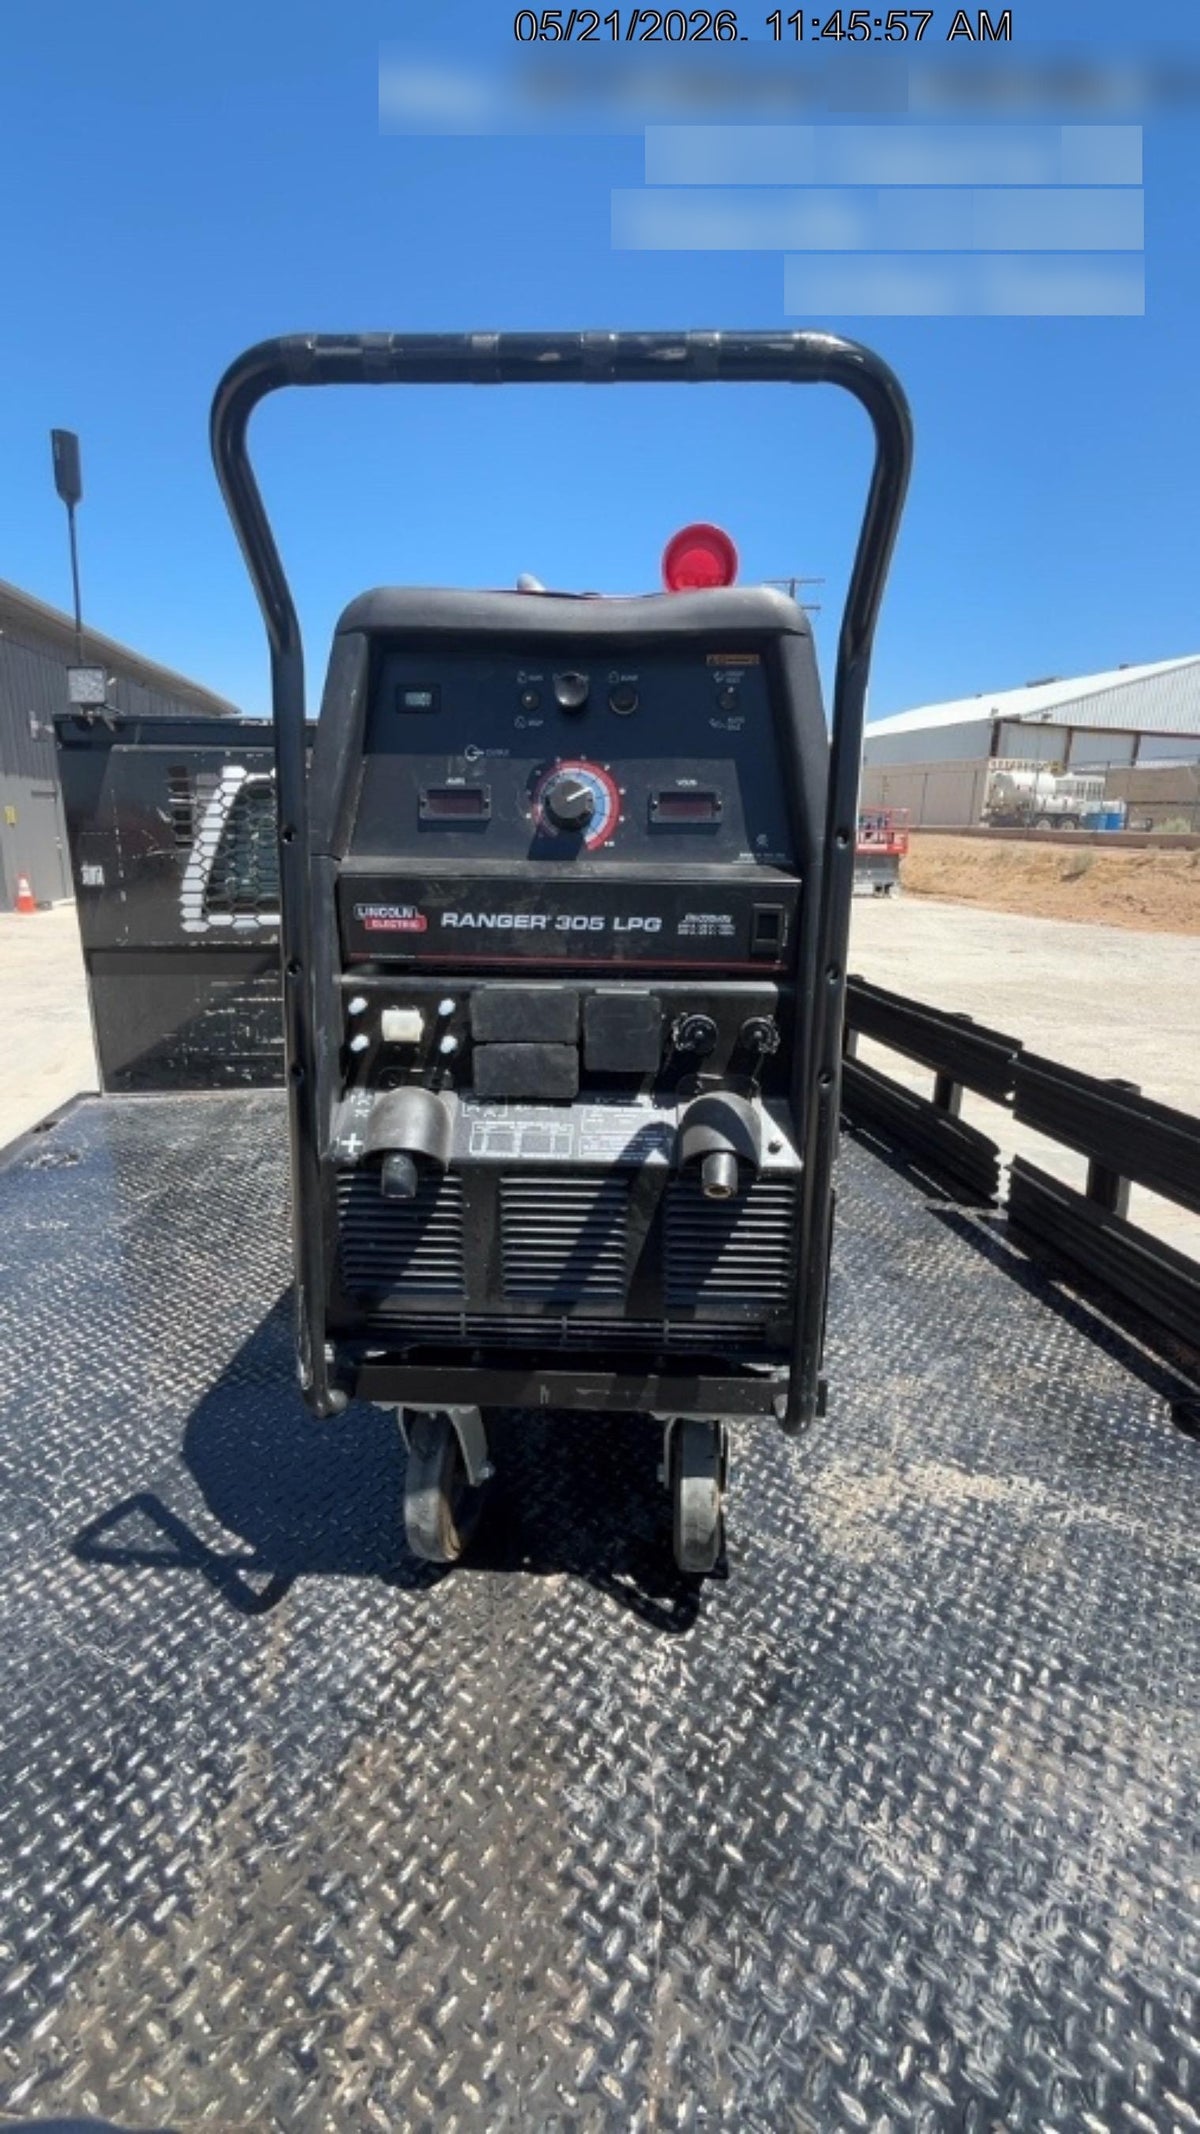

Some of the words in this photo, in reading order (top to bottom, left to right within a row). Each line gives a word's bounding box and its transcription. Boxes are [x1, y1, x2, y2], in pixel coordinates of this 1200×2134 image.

[357, 907, 413, 918] LINCOLN
[440, 912, 547, 929] RANGER
[555, 914, 606, 931] 305
[613, 917, 663, 932] LPG
